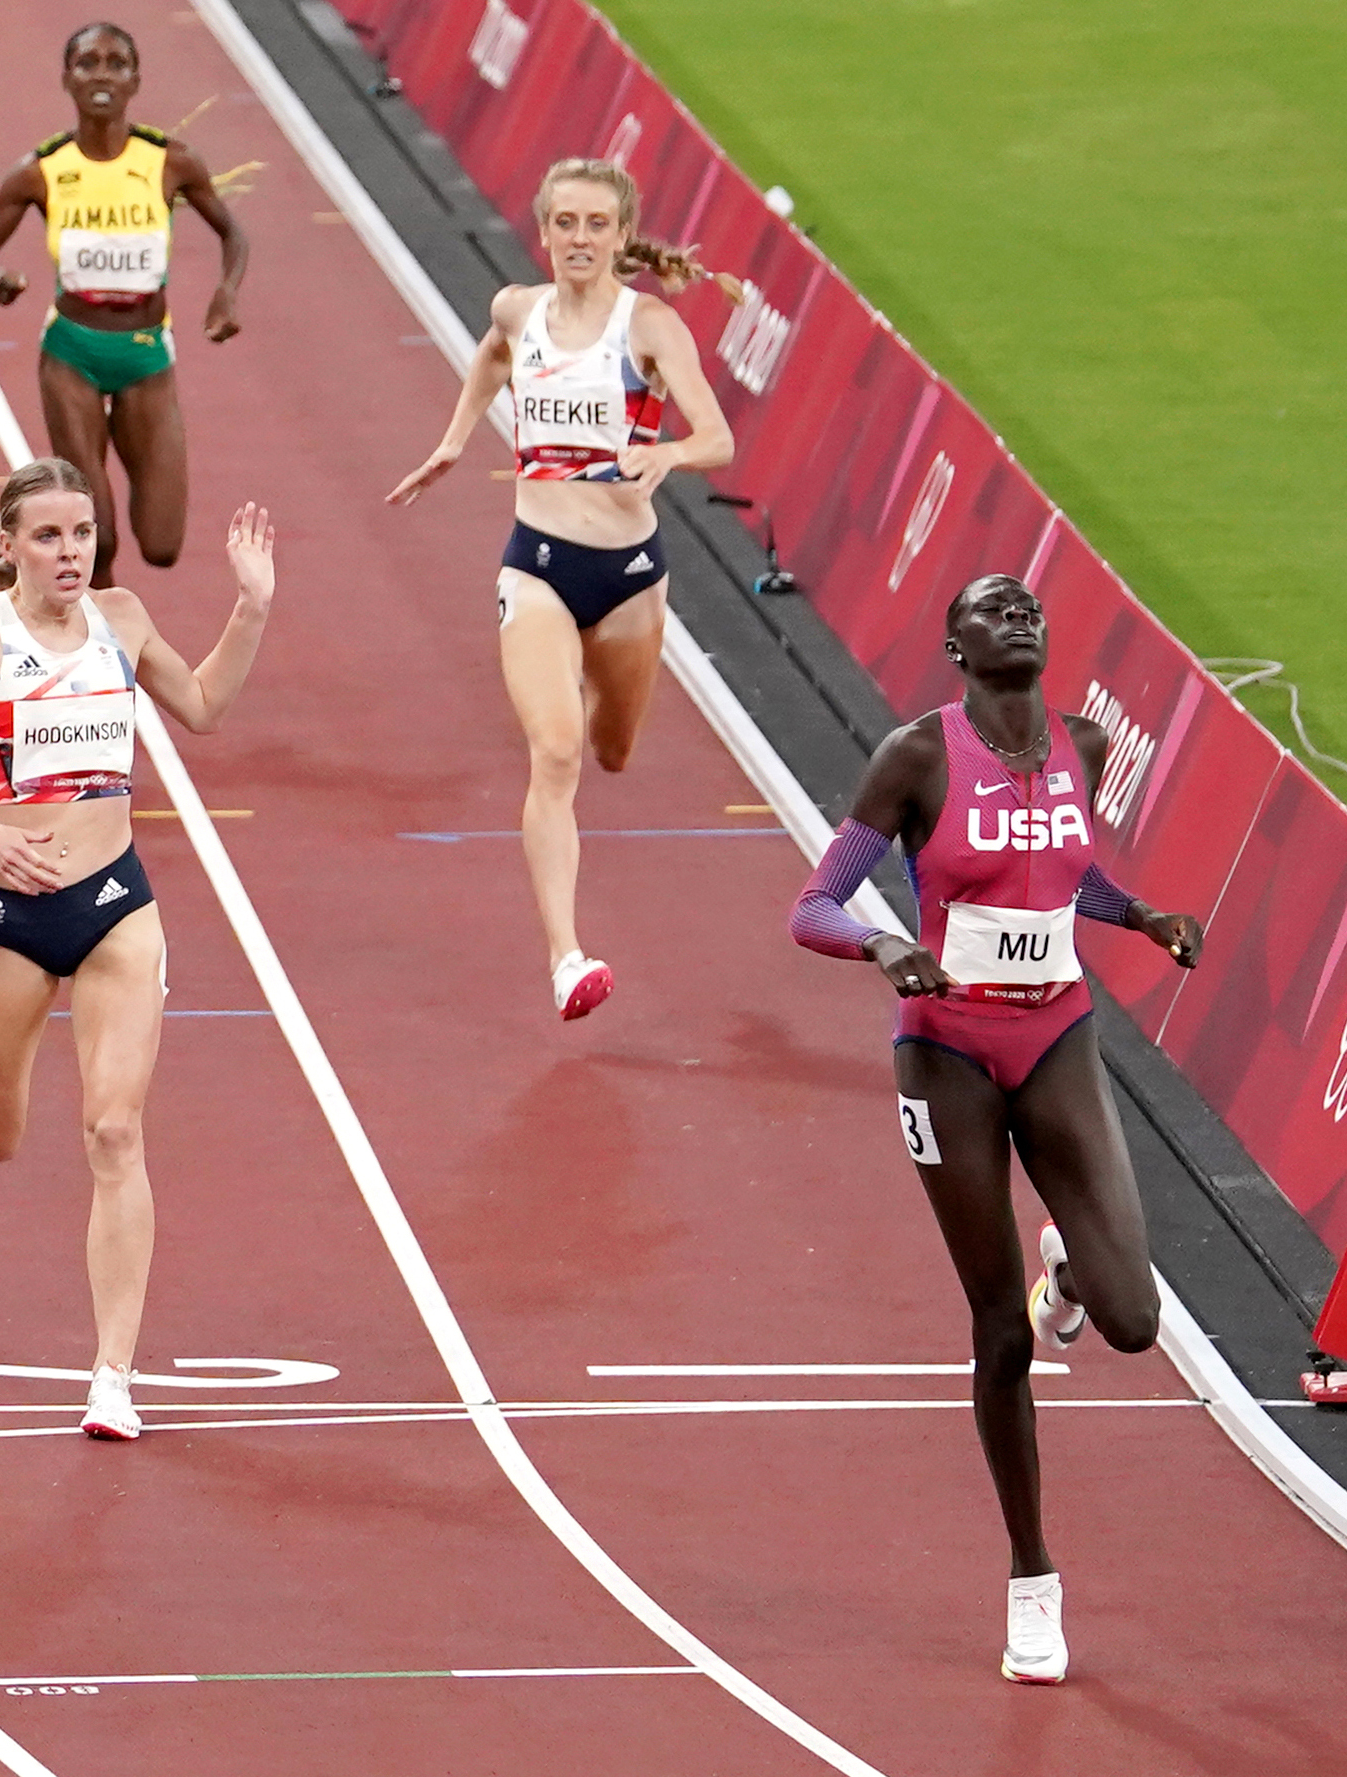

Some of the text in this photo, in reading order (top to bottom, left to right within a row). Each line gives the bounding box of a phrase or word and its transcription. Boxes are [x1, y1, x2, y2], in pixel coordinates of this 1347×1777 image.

[60, 203, 158, 229] JAMAICA
[77, 248, 153, 271] GOULE
[525, 397, 609, 425] REEKIE
[24, 721, 128, 745] HODGKINSON
[967, 804, 1090, 852] USA
[997, 932, 1050, 961] MU
[902, 1105, 924, 1155] 3
